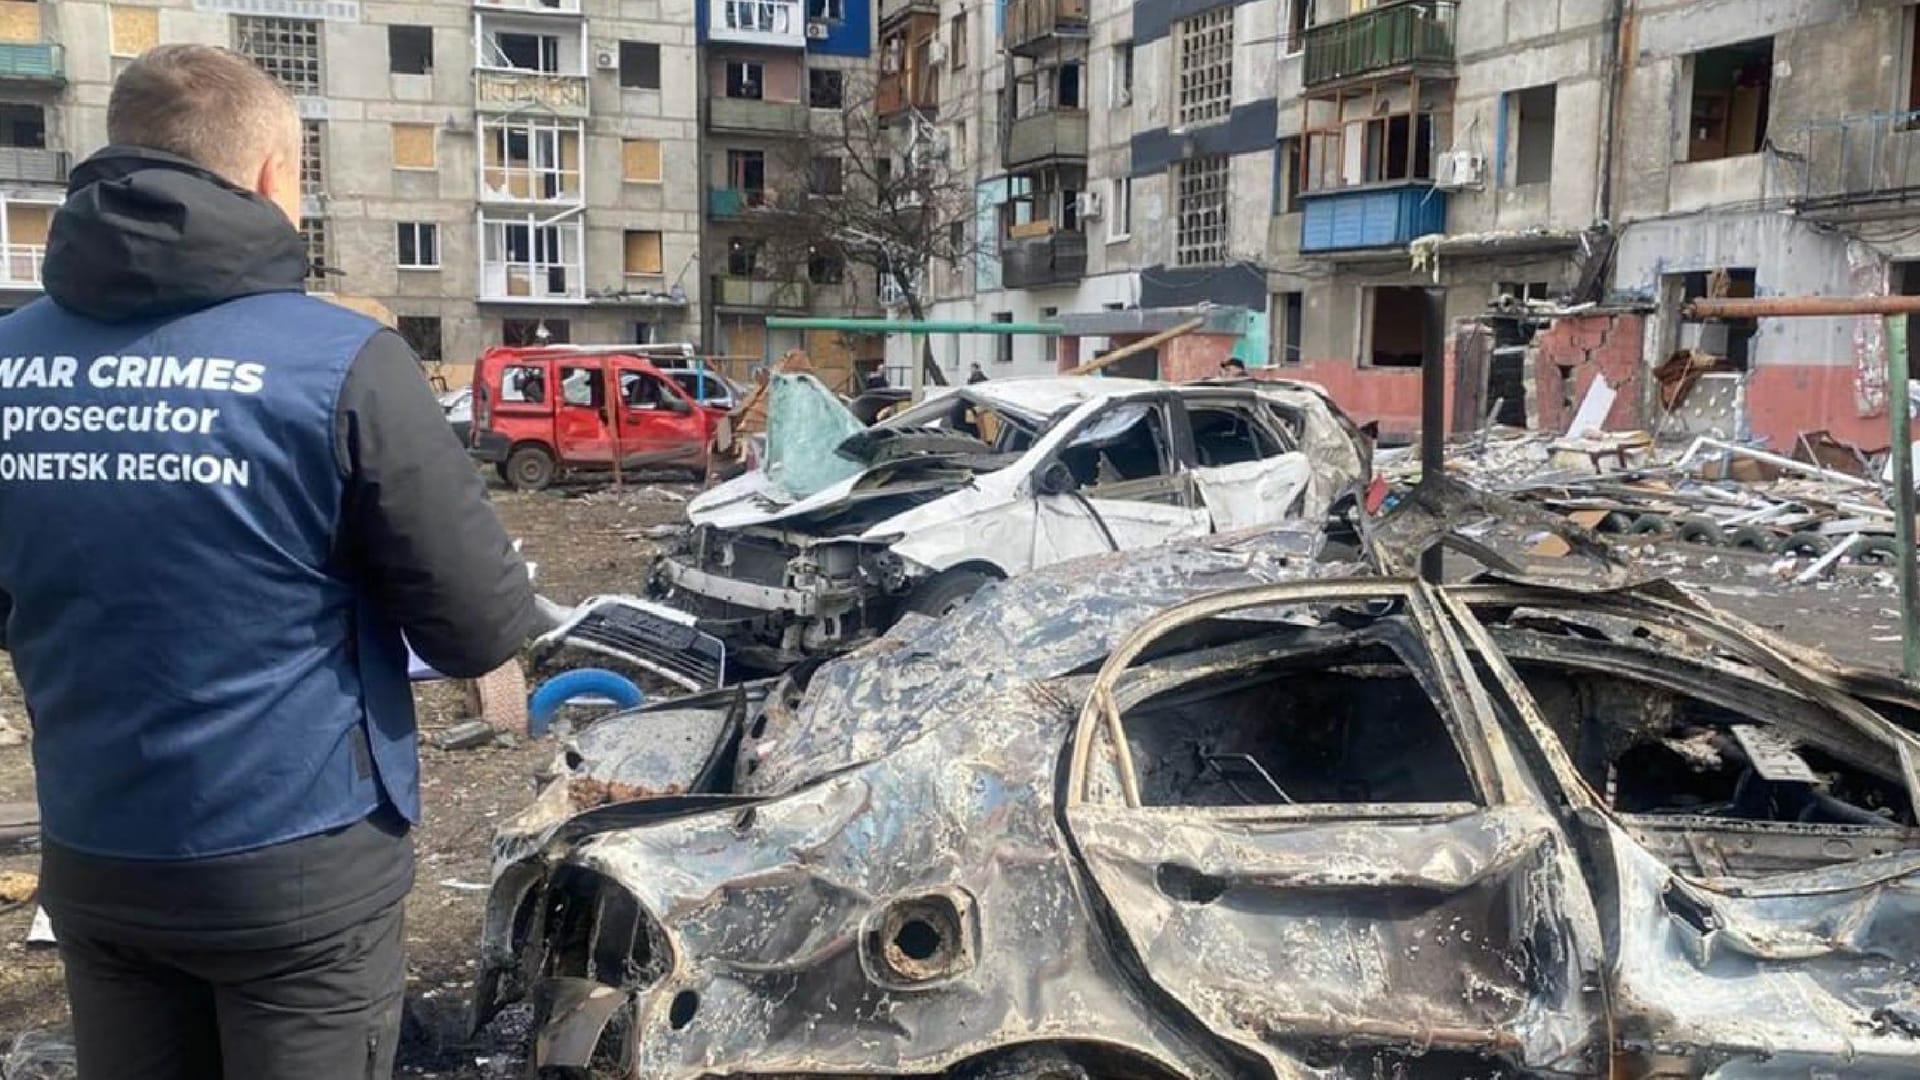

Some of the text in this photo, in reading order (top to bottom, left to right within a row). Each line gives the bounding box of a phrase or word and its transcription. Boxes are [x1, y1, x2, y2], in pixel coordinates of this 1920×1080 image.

[88, 356, 266, 394] CRIMES
[3, 400, 220, 440] prosecutor
[0, 452, 249, 486] ONETSK REGION
